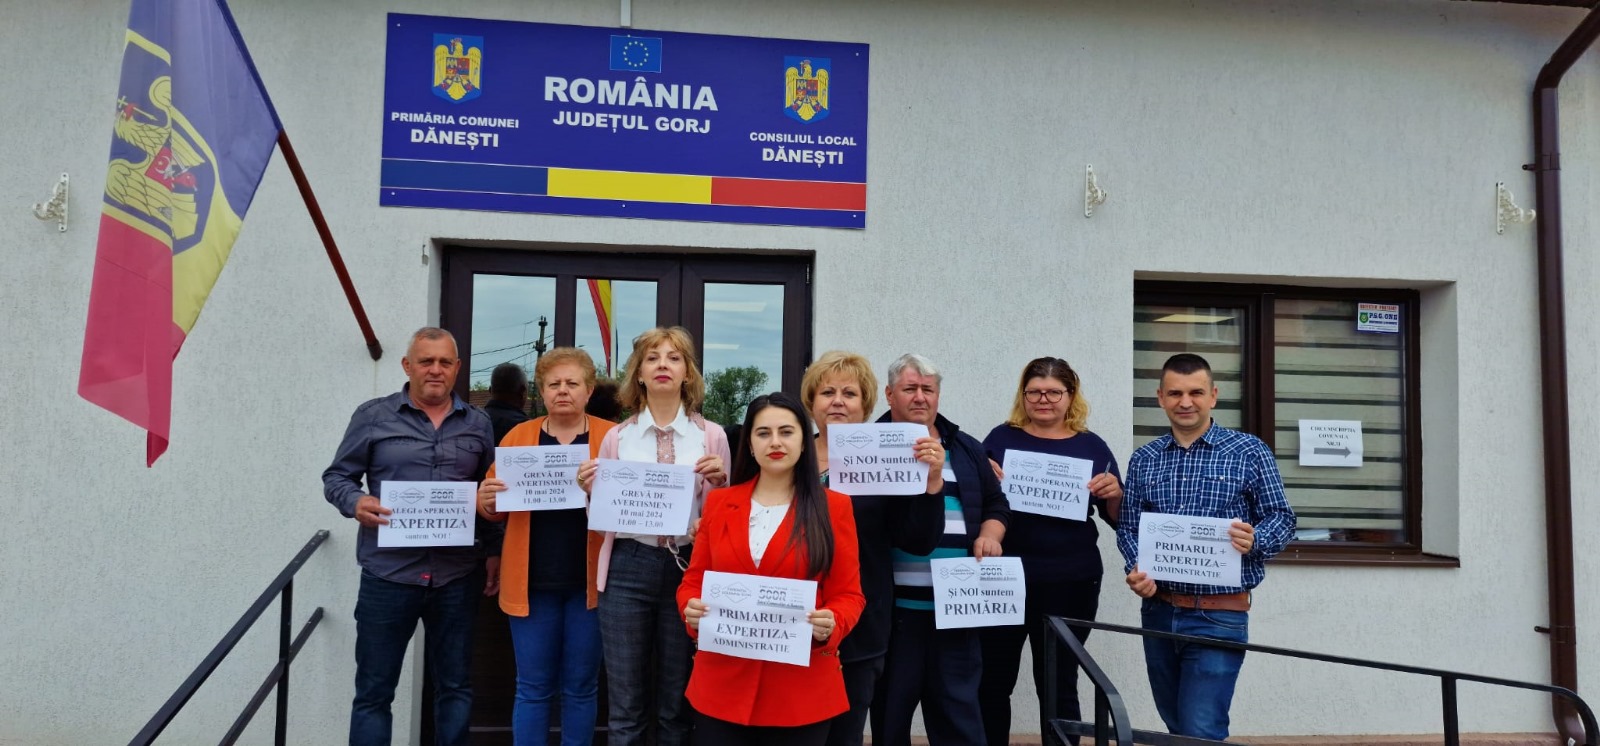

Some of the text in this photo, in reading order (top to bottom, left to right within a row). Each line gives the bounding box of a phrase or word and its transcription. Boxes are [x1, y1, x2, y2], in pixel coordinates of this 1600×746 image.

[545, 76, 718, 111] ROMÂNIA
[391, 112, 519, 129] PRIMĂRIA COMUNEI
[552, 111, 711, 134] JUDEȚUL GORJ
[411, 127, 499, 150] DĂNEȘTI
[750, 132, 857, 146] CONSILIUL LOCAL
[762, 145, 844, 168] DĂNEȘTI
[880, 433, 905, 443] SCOR
[545, 454, 568, 463] SCOR
[843, 455, 853, 467] Și
[856, 455, 878, 464] NOI
[1048, 463, 1070, 473] SCOR
[523, 470, 553, 479] GREVĂ
[645, 472, 670, 483] SCOR
[839, 467, 922, 484] PRIMĂRIA
[1011, 474, 1034, 482] ALEGI
[515, 479, 573, 488] AVERTISMENT
[431, 491, 454, 499] SCOR
[621, 489, 666, 500] GREVĂ DE
[1008, 483, 1081, 504] EXPERTIZA
[611, 499, 673, 509] AVERTISMENT
[1021, 500, 1044, 508] suntem
[392, 507, 417, 515] ALEGI
[630, 509, 645, 517] mai
[389, 518, 467, 529] EXPERTIZA
[1190, 526, 1216, 536] SCOR
[1155, 541, 1217, 555] PRIMARUL
[1154, 554, 1227, 568] EXPERTIZA=
[980, 567, 1003, 576] SCOR
[758, 588, 787, 602] SCOR
[948, 587, 957, 598] Și
[960, 587, 978, 597] NOI
[944, 599, 1018, 615] PRIMĂRIA
[719, 608, 798, 624] PRIMARUL +
[716, 623, 797, 640] EXPERTIZA=
